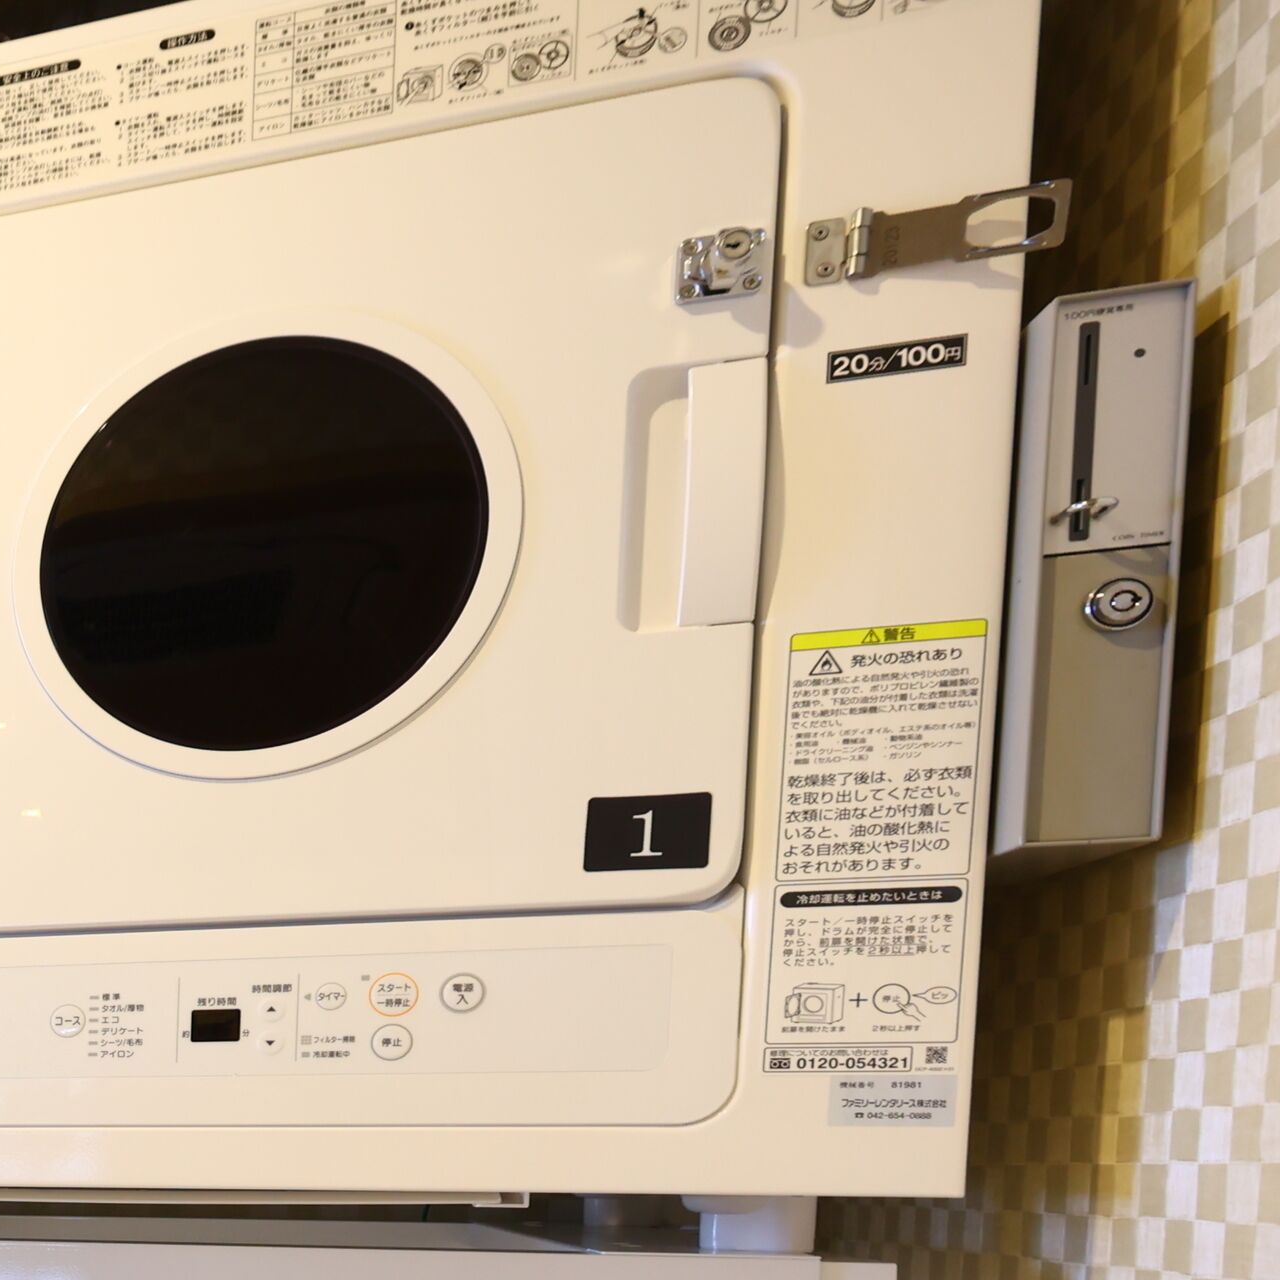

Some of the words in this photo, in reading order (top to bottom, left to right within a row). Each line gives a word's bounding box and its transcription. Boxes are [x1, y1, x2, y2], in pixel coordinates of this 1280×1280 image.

[167, 31, 207, 48] 操作方法
[2, 63, 69, 84] 安全上のご注意
[832, 342, 962, 376] 20分/100円
[884, 626, 916, 642] 警告
[850, 648, 963, 668] 発火の恐れあり
[792, 667, 969, 688] 油の酸化熱による自然発火や引火の恐れ
[788, 765, 973, 790] 乾燥終了後は、必ず衣類
[787, 785, 962, 807] を取り出してください。
[785, 801, 970, 824] 衣類に油などが付着して
[630, 810, 663, 857] 1
[784, 820, 950, 840] いると、油の酸化熱に
[783, 837, 949, 858] よる自然発火や引火の
[782, 857, 922, 875] おそれがあります。
[796, 890, 943, 905] 冷却運転を止めたいときは
[783, 958, 835, 967] ください。
[252, 983, 293, 994] 時間調節
[377, 983, 412, 993] スタート
[452, 983, 474, 993] 電源
[197, 997, 237, 1007] 残り時間
[318, 991, 345, 1001] タイマー
[456, 994, 469, 1005] 入
[377, 999, 411, 1008] 一時停止
[55, 1016, 81, 1026] コース
[101, 1026, 144, 1036] デリケート
[100, 1038, 143, 1047] シーツ/毛布
[381, 1038, 402, 1048] 停止
[100, 1049, 134, 1058] アイロン
[797, 1057, 908, 1070] 0120-054321
